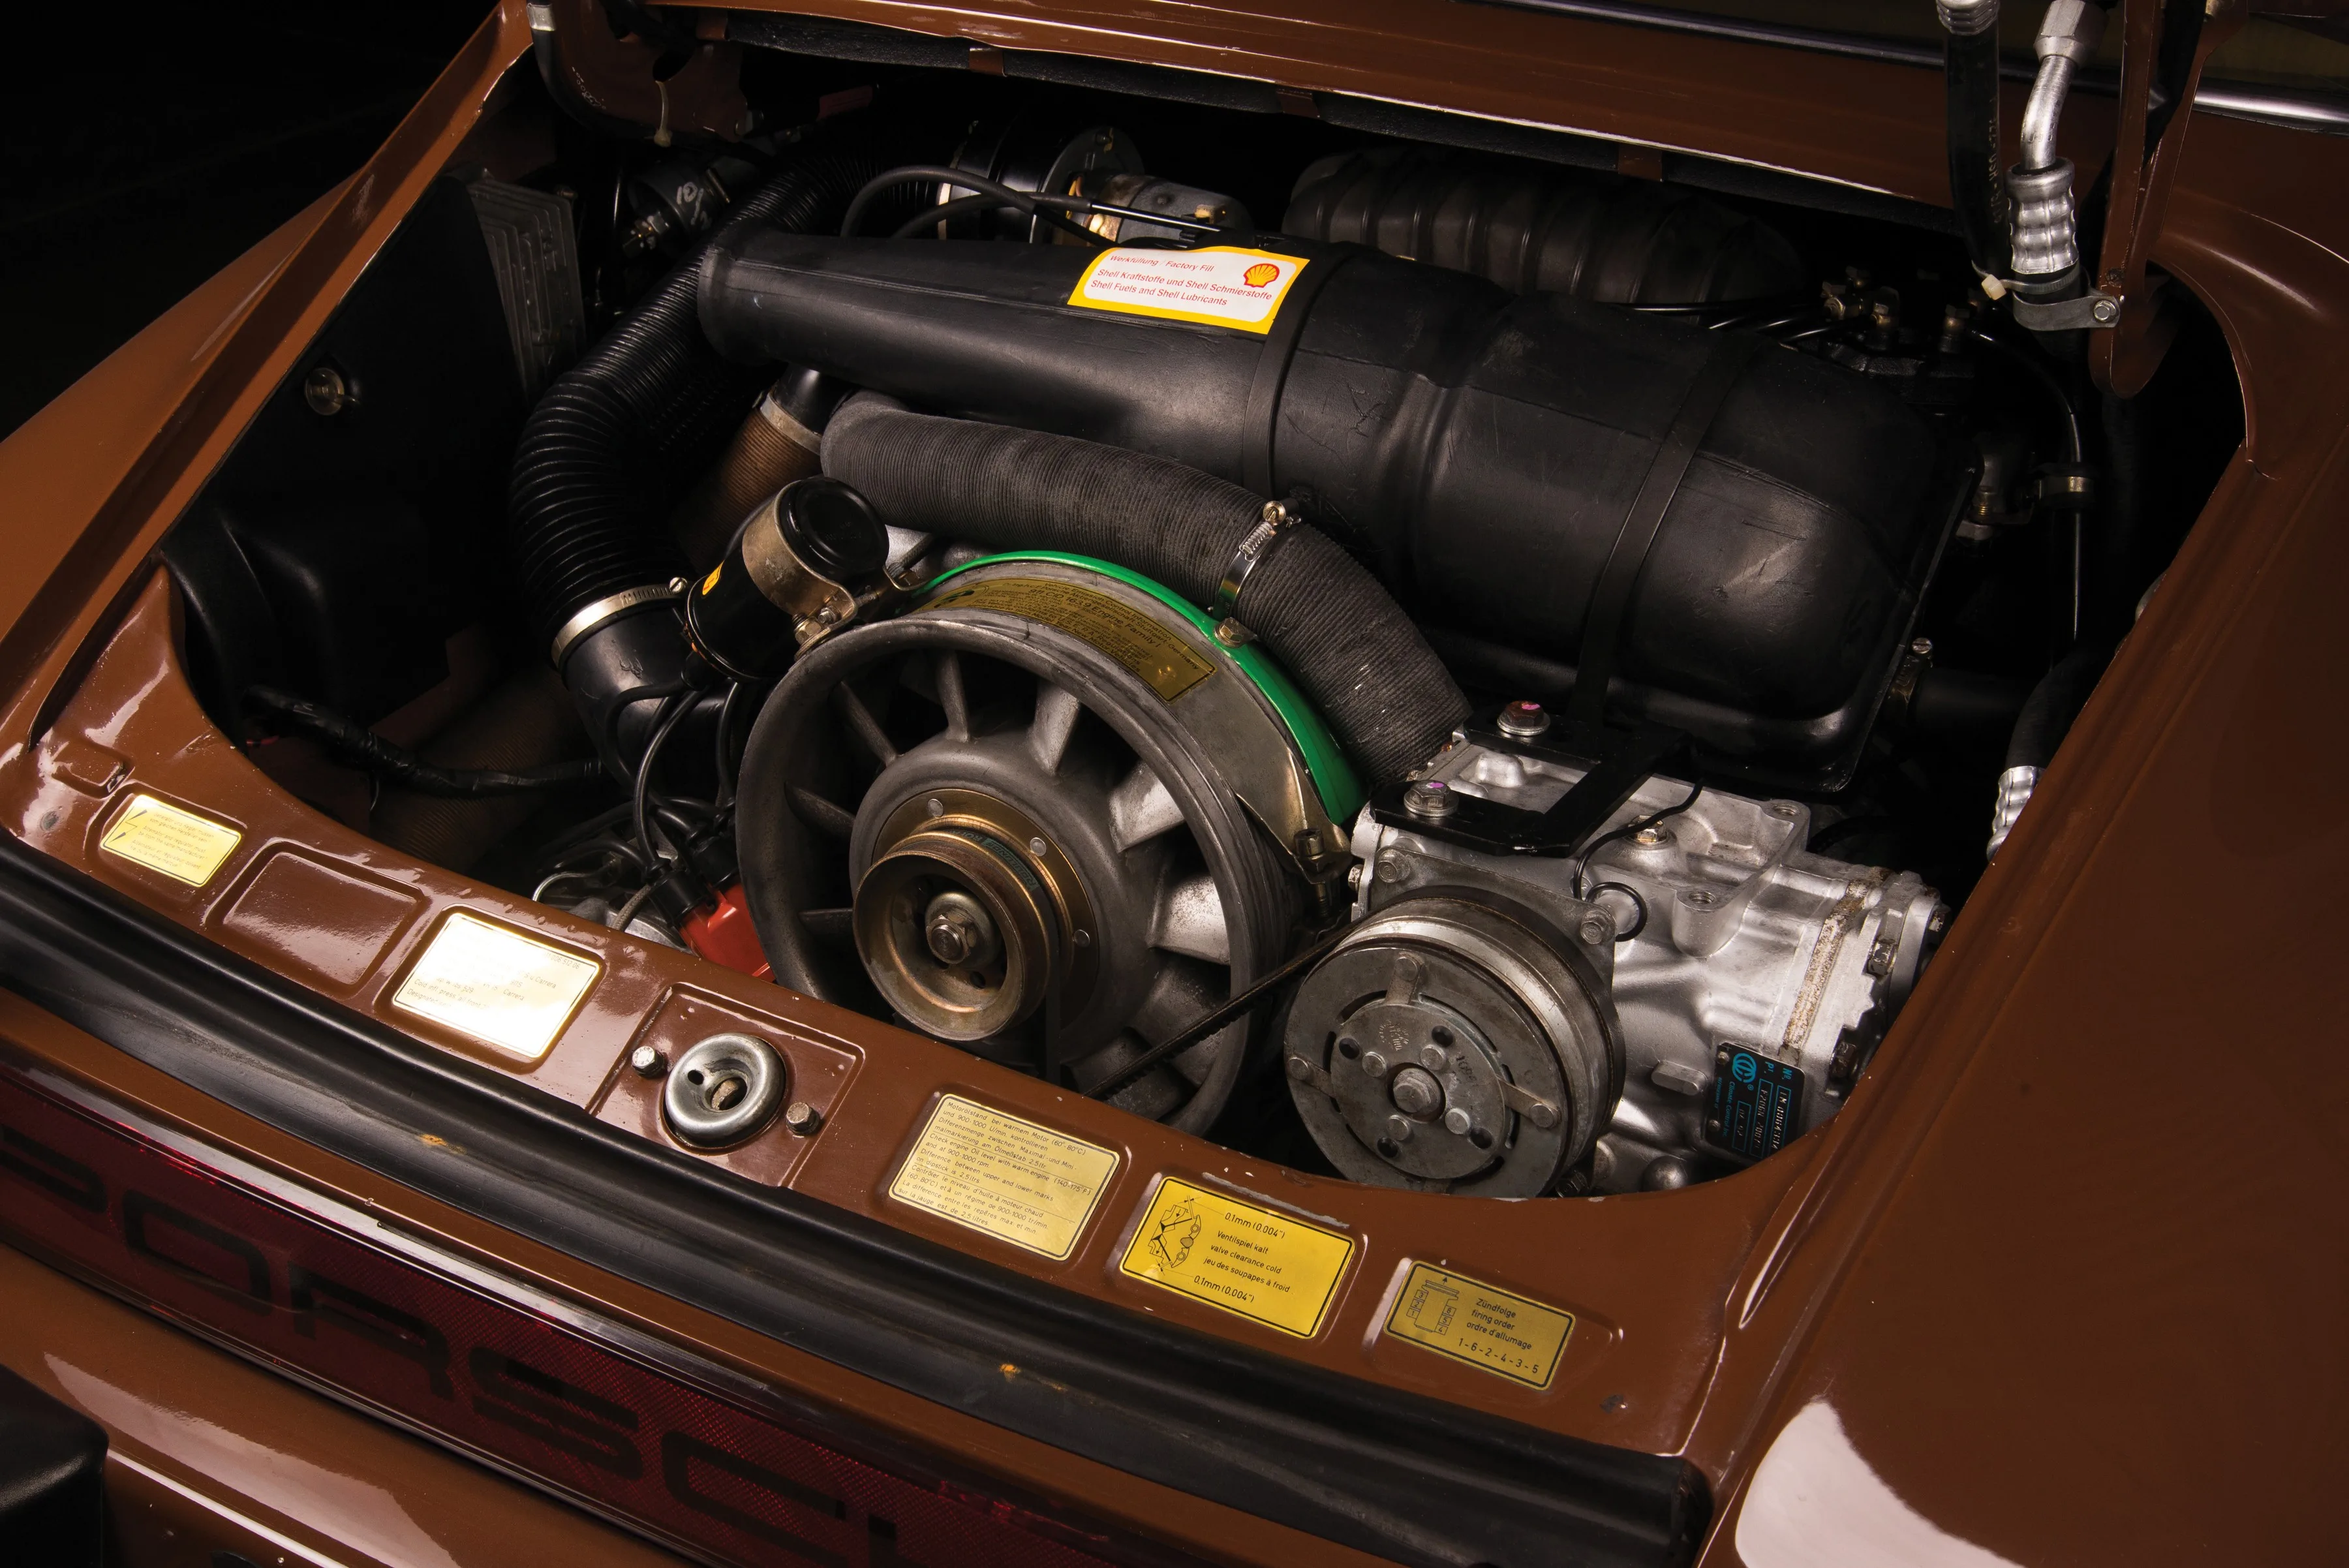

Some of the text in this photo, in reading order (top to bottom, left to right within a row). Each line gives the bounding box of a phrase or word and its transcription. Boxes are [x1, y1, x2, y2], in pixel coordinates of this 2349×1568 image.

[1110, 255, 1159, 266] Werkfüllung
[1165, 260, 1198, 271] Factory
[1090, 279, 1113, 289] Shell
[1113, 283, 1137, 292] Fuels
[1157, 288, 1180, 298] Shell
[1180, 292, 1227, 305] Lubricants
[1098, 269, 1120, 277] Shell
[1120, 271, 1165, 283] Kraftstoffe
[1185, 280, 1208, 289] Shell
[1209, 283, 1272, 300] Schmierstoffe
[1071, 589, 1104, 602] Emission
[1105, 600, 1132, 616] Control
[1131, 613, 1172, 641] Information
[1092, 606, 1124, 625] Engine
[1125, 623, 1156, 645] Family
[1071, 628, 1088, 638] New
[413, 978, 428, 988] Cold
[502, 988, 526, 1001] Carrera
[534, 976, 558, 989] Carrera
[938, 1116, 984, 1137] Differenzmenge
[987, 1135, 1015, 1148] zwischen
[947, 1101, 987, 1120] Motorölstand
[1003, 1123, 1029, 1135] warmem
[1031, 1131, 1049, 1142] Motor
[933, 1125, 979, 1145] malmarkierung
[994, 1145, 1026, 1161] Ölmeßstab
[1010, 1133, 1048, 1151] kontrollieren
[926, 1160, 948, 1171] dipstick
[929, 1133, 948, 1143] Check
[949, 1141, 968, 1151] engine
[981, 1152, 996, 1161] level
[1012, 1163, 1029, 1173] warm
[1030, 1171, 1049, 1181] engine
[920, 1148, 951, 1163] Difference
[955, 1160, 980, 1173] between
[983, 1172, 1000, 1180] upper
[1015, 1183, 1032, 1192] lower
[1034, 1191, 1053, 1201] marks
[912, 1164, 939, 1178] Contrôler
[949, 1180, 970, 1190] niveau
[973, 1188, 993, 1199] d'huile
[1001, 1199, 1022, 1209] moteur
[1024, 1208, 1043, 1218] chaud
[912, 1184, 942, 1198] difference
[944, 1197, 960, 1205] entre
[916, 1195, 934, 1205] jauge
[964, 1195, 985, 1205] régime
[1218, 1230, 1268, 1254] Ventilspiel kalt
[1210, 1244, 1282, 1274] valve clearance cold
[1216, 1261, 1229, 1270] des
[1230, 1267, 1265, 1283] soupapes
[1272, 1281, 1290, 1292] froid
[1471, 1309, 1515, 1330] firing order
[1475, 1297, 1516, 1317] Zündfolge
[1466, 1322, 1531, 1349] ordre d'allumage
